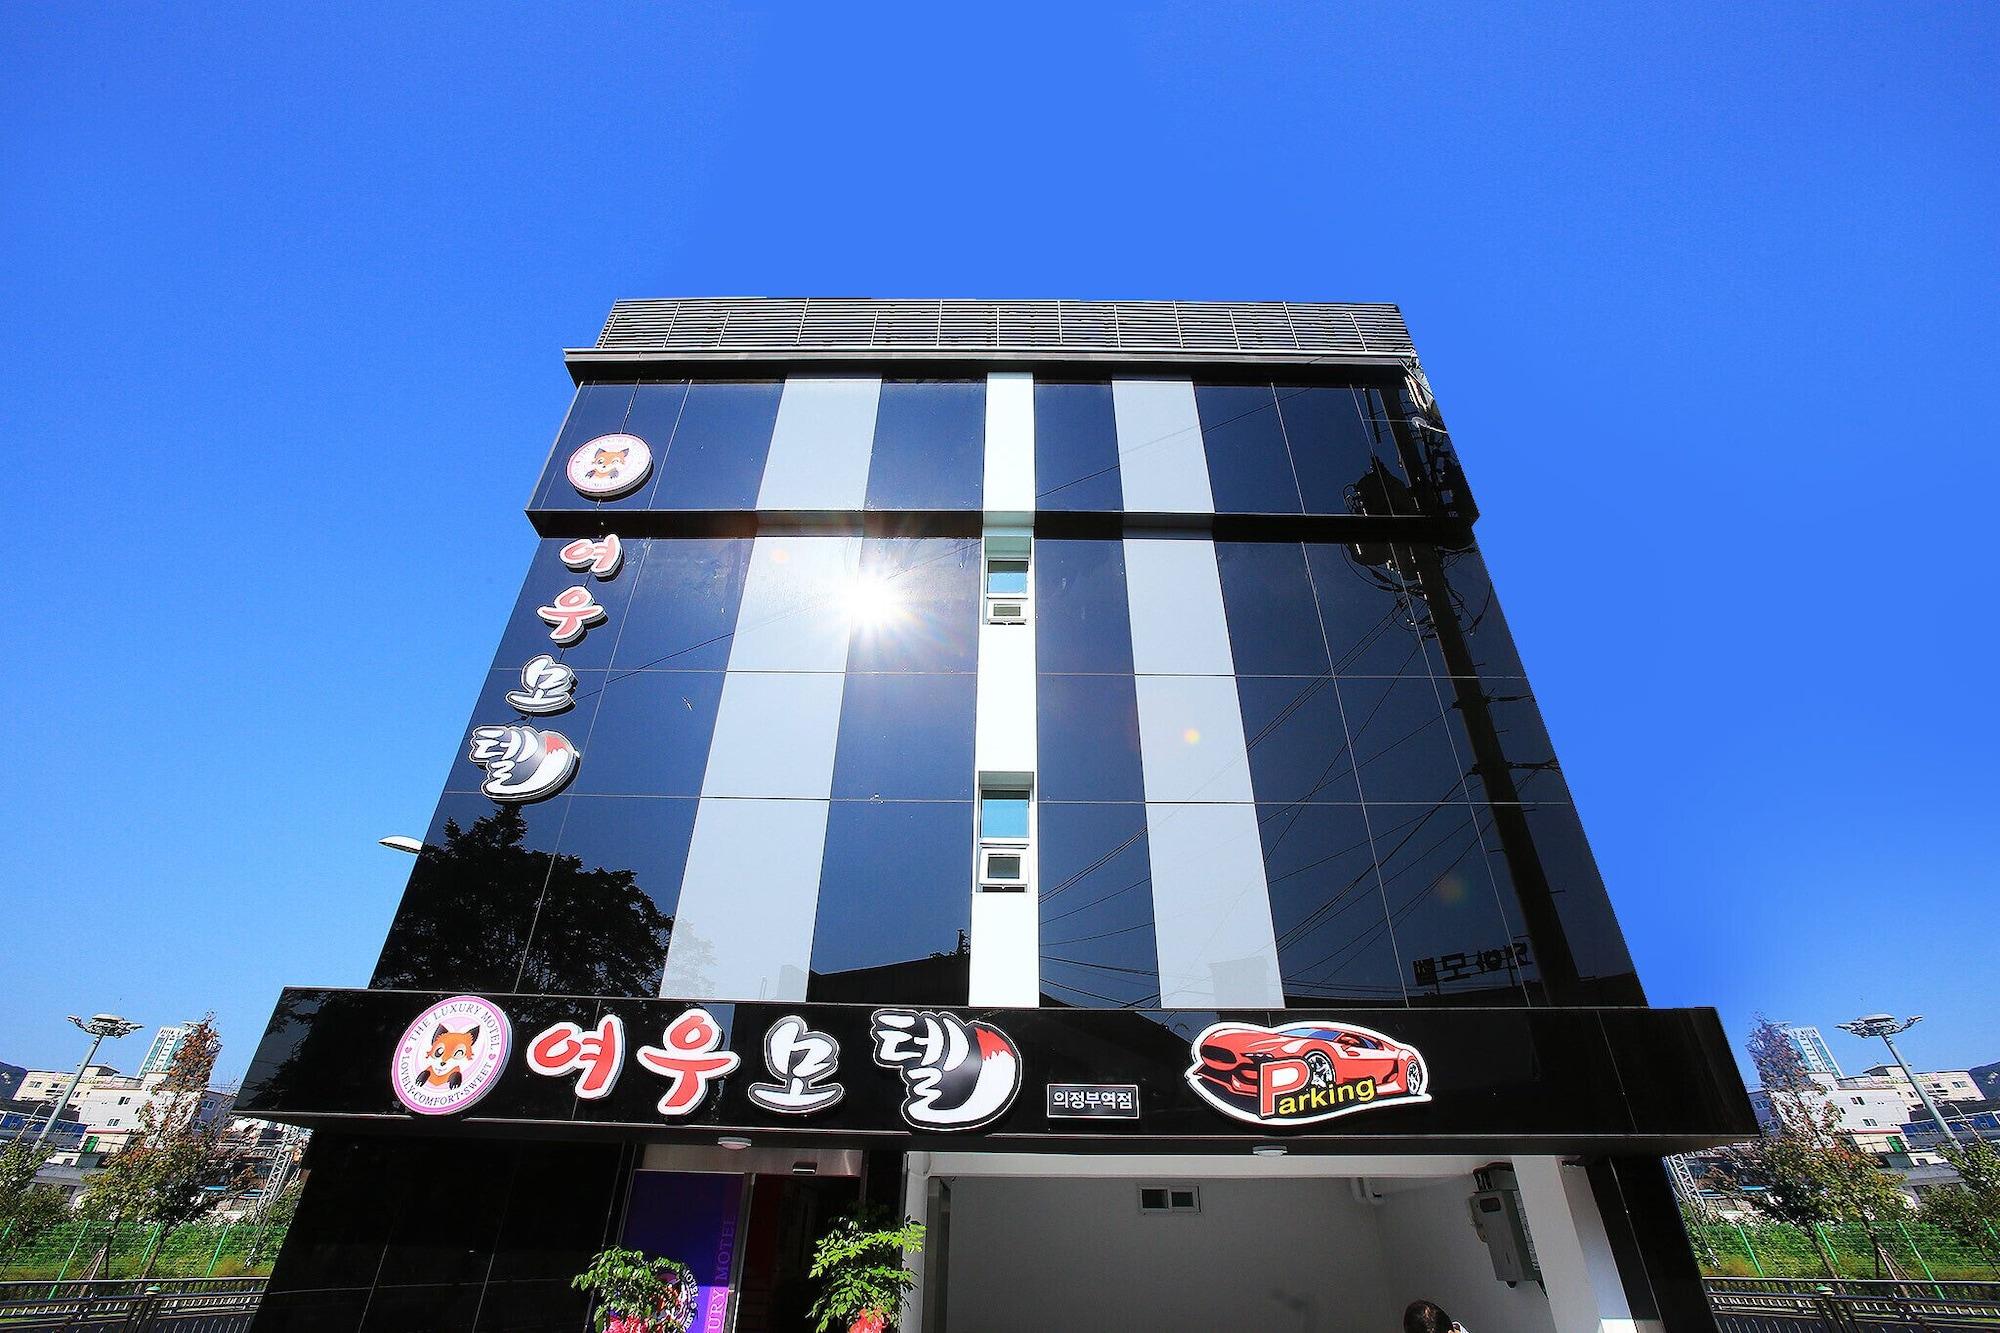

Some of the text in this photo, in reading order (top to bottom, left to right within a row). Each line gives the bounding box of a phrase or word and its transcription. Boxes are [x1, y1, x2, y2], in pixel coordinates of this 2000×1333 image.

[409, 1003, 500, 1050] THE LUXURY MOTEL
[463, 1062, 492, 1095] SWEET
[1053, 1091, 1133, 1110] 의정부역점
[1259, 1058, 1376, 1117] Parking
[707, 1288, 726, 1333] URY
